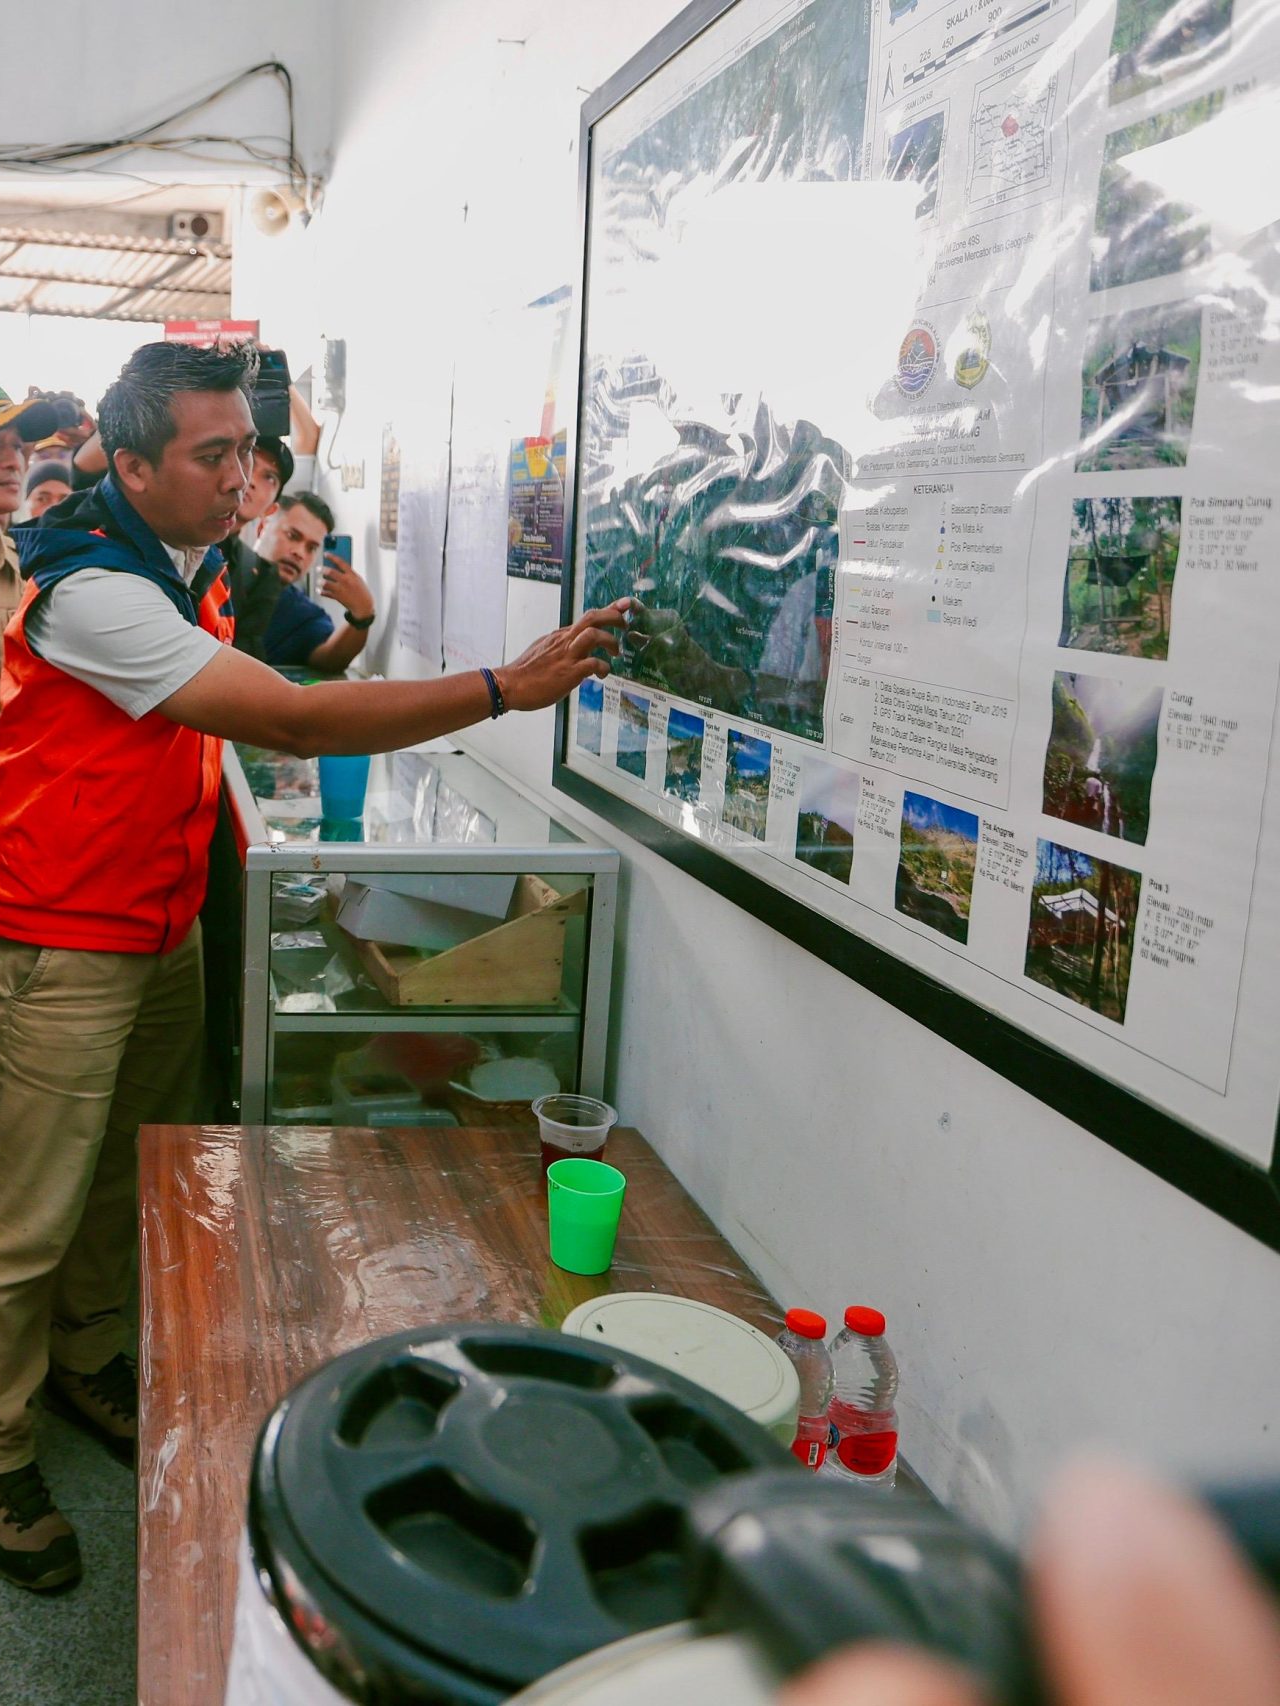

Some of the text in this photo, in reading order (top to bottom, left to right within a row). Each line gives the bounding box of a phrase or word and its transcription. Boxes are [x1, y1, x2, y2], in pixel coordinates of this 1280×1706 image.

[988, 7, 1002, 23] 900
[919, 49, 932, 63] 225
[941, 35, 954, 50] 450
[952, 240, 967, 252] Zone
[964, 246, 992, 262] Mercator
[964, 453, 997, 466] Universitas
[998, 452, 1025, 464] Semarang
[913, 484, 954, 495] KETERANGAN
[1245, 495, 1272, 510] Curug
[951, 522, 961, 534] Pos
[950, 541, 962, 553] Pos
[948, 560, 970, 572] Puncak
[871, 620, 890, 632] Makam
[942, 612, 961, 626] Segara
[893, 641, 903, 653] 100
[880, 680, 892, 693] Data
[892, 683, 911, 698] Spasial
[941, 693, 971, 710] Indonesia
[971, 700, 990, 715] Tahun
[991, 704, 1008, 719] 2019
[1170, 691, 1193, 707] Curug
[880, 693, 892, 706] Data
[892, 695, 905, 708] Citra
[905, 699, 923, 715] Google
[923, 703, 938, 718] Maps
[939, 708, 956, 721] Tahun
[956, 711, 972, 725] 2021
[879, 707, 892, 719] GPS
[892, 709, 906, 723] Track
[907, 713, 934, 730] Pendakian
[934, 720, 950, 734] Tahun
[950, 725, 964, 739] 2021
[872, 721, 884, 735] Peta
[890, 726, 908, 741] Dibuat
[908, 730, 927, 746] Dalam
[927, 735, 948, 752] Rangka
[948, 742, 964, 757] Masa
[964, 746, 998, 767] Pengabdian
[869, 746, 897, 765] Tahun 2021
[922, 749, 936, 763] Alam
[936, 751, 967, 774] Universitas
[967, 762, 1000, 785] Semarang
[982, 819, 1015, 839] Pos Anggrek
[1148, 877, 1163, 892] Pos
[1166, 945, 1196, 966] Anggrek
